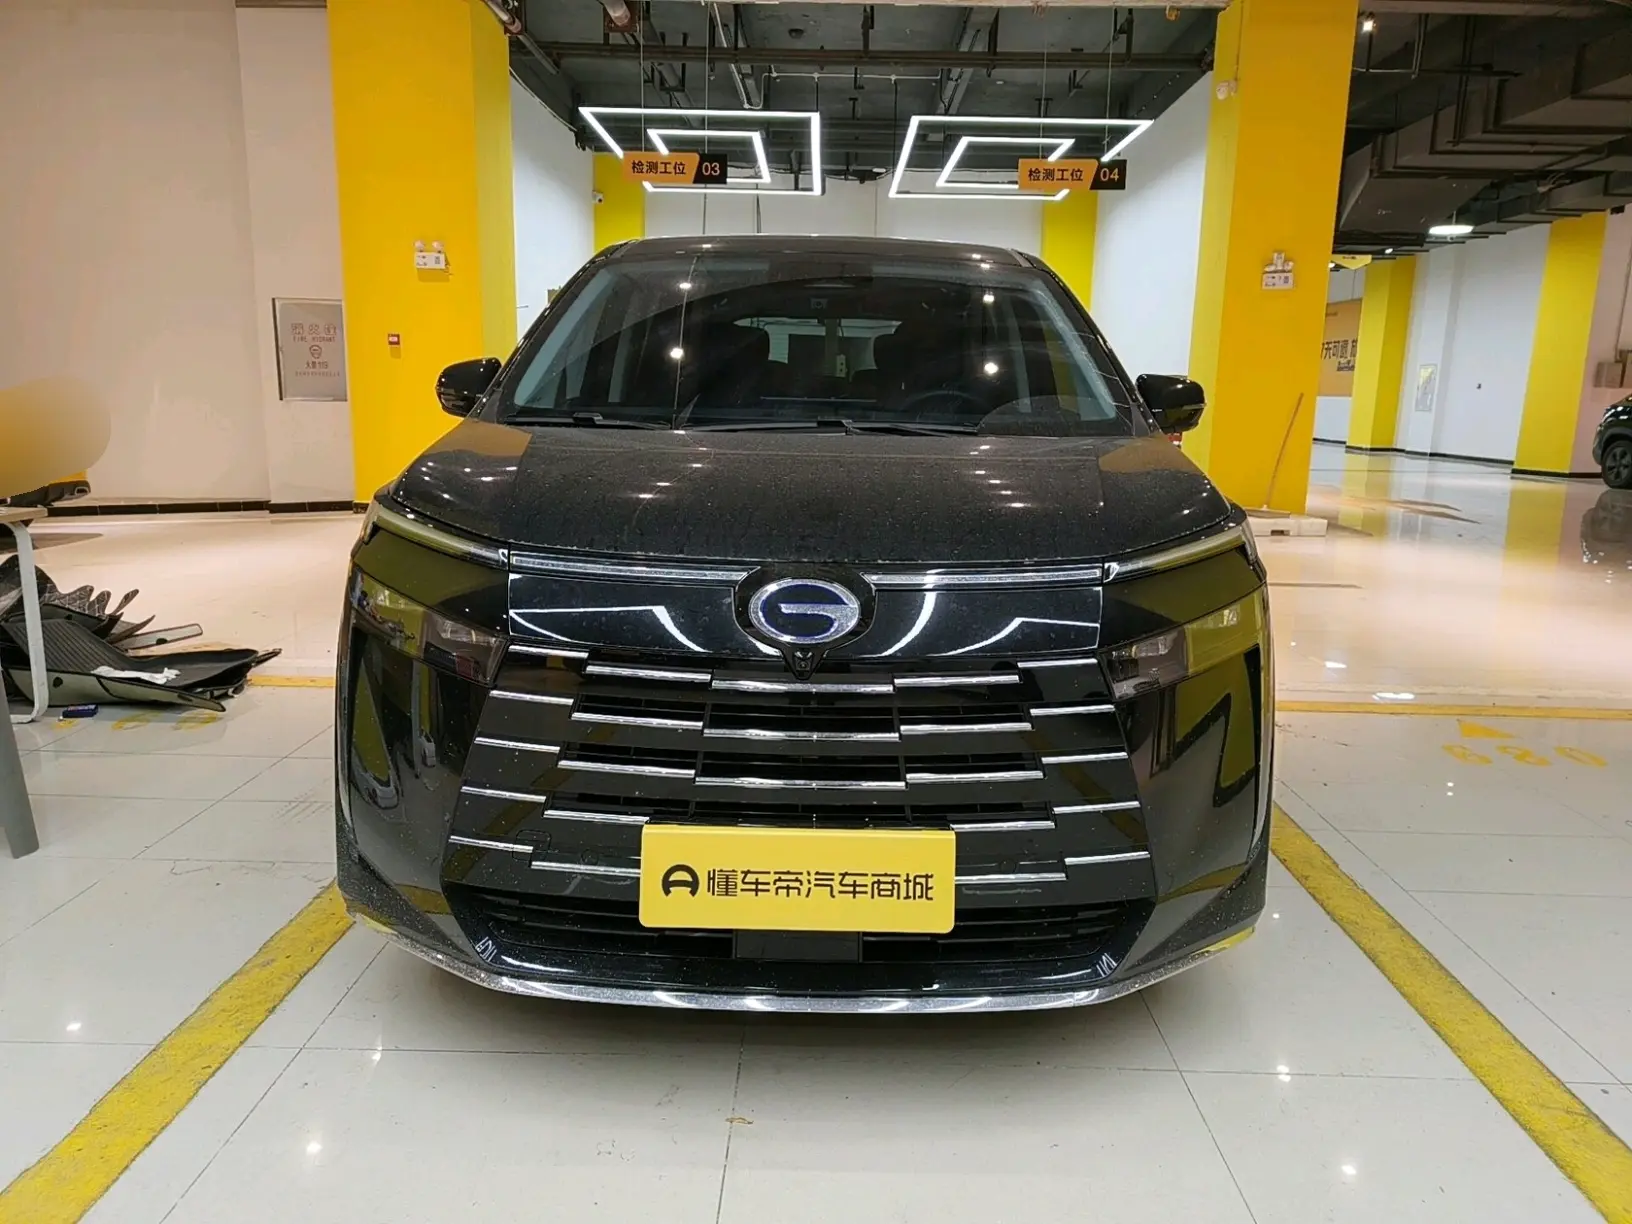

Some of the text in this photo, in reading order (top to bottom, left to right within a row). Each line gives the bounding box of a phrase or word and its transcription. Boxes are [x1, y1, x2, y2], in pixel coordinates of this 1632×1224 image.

[632, 160, 720, 176] 检测工位 03
[1028, 167, 1119, 182] 检测工位 04
[706, 867, 934, 901] 懂车帝汽车商城
